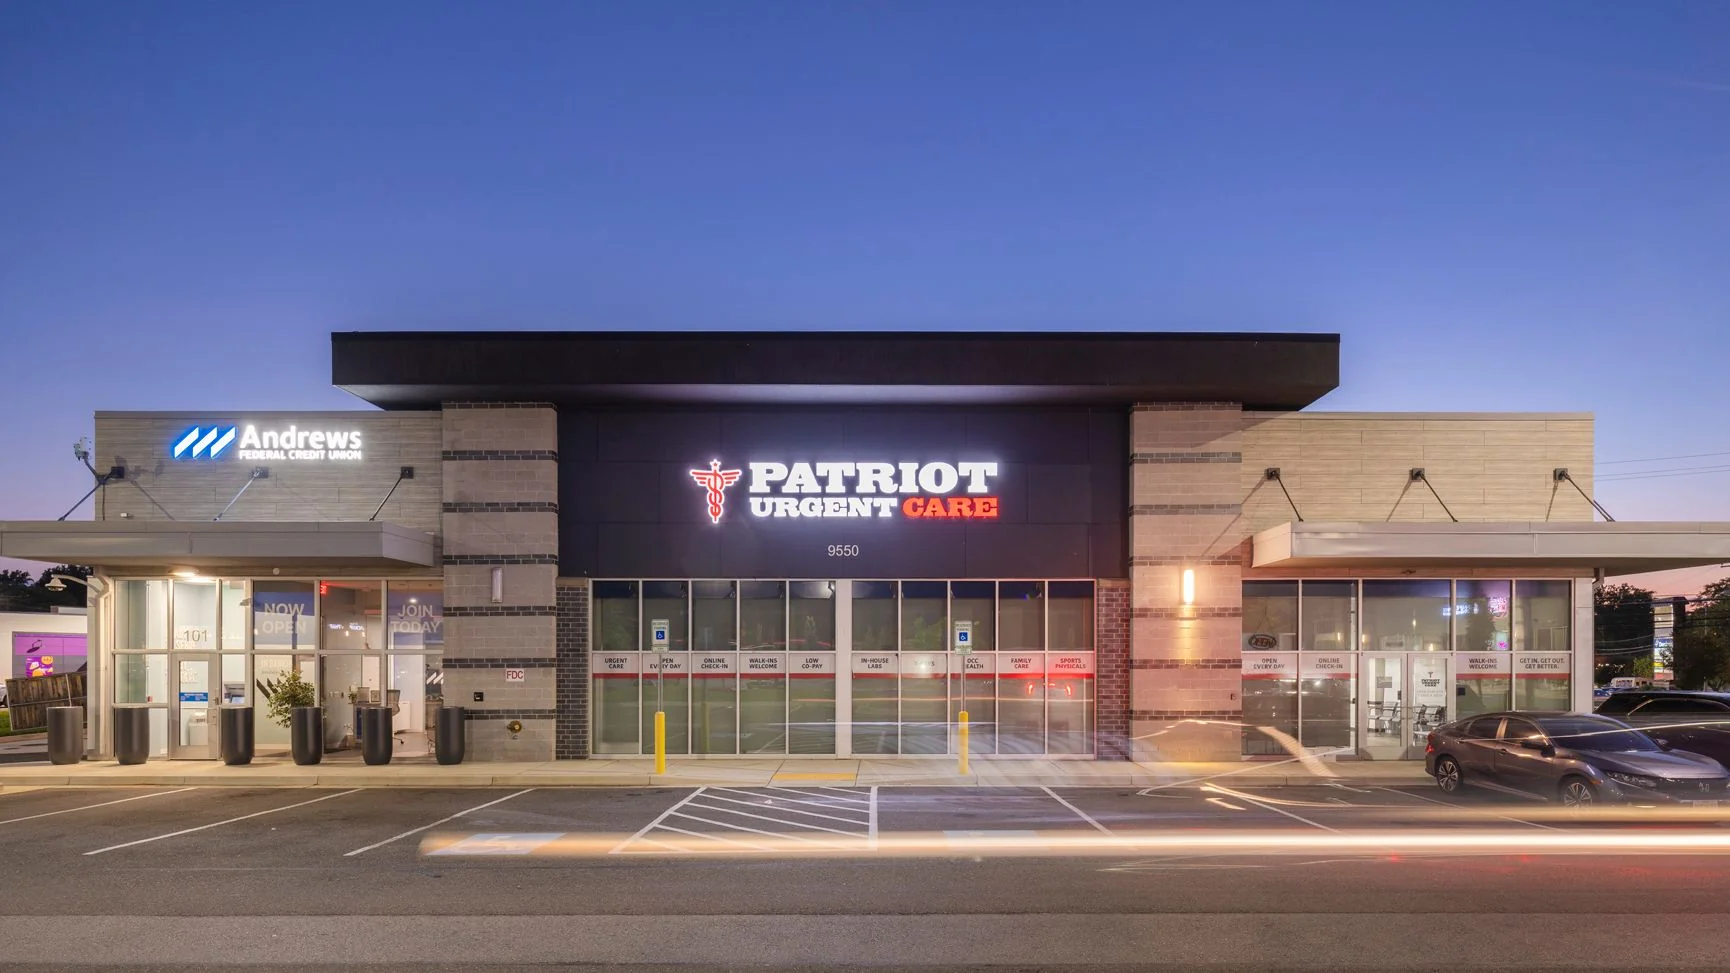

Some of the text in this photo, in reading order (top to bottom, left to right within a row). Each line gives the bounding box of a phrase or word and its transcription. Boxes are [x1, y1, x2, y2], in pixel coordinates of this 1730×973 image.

[239, 424, 362, 450] Andrews
[239, 450, 362, 461] FEDERAL CREDIT UNION
[748, 461, 999, 494] PATRIOT
[749, 496, 999, 519] URGENT CARE
[826, 544, 860, 559] 9550
[264, 602, 305, 616] NOW
[397, 604, 434, 618] JOIN
[262, 620, 307, 635] OPEN
[392, 621, 441, 634] TODAY
[183, 629, 208, 642] 101
[506, 670, 524, 680] FDC
